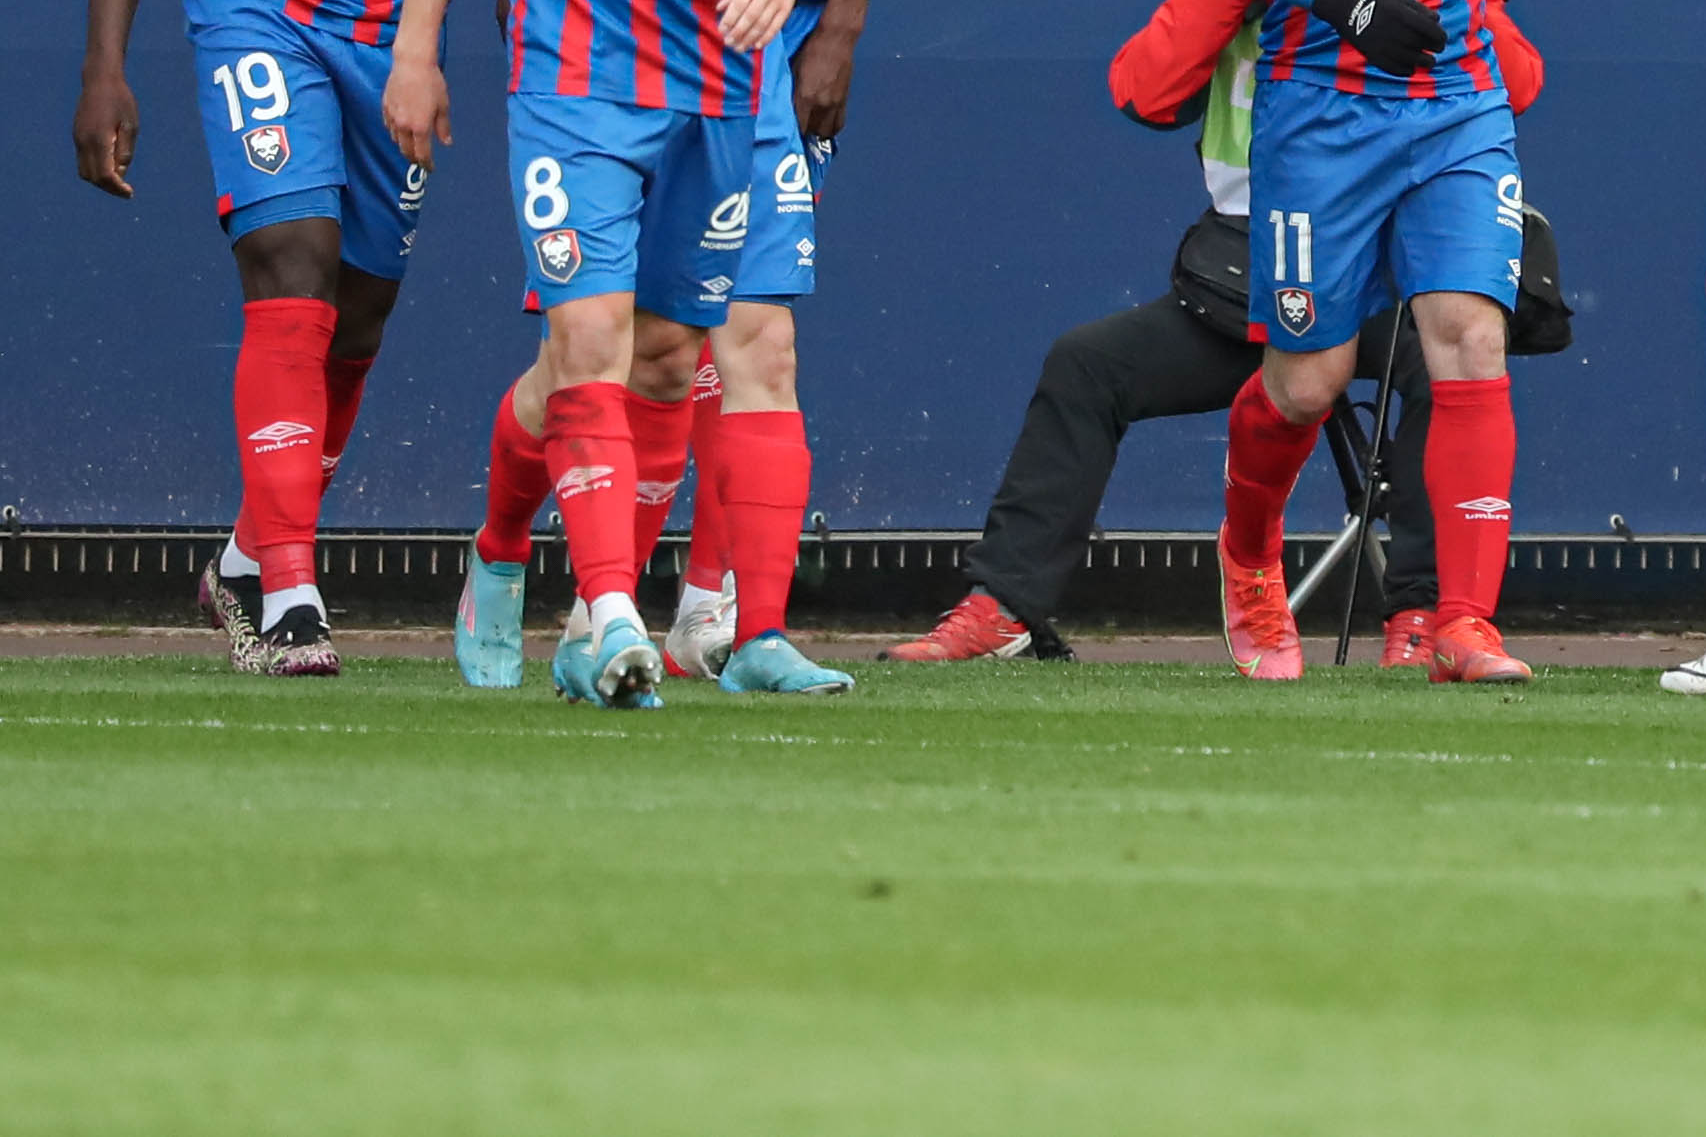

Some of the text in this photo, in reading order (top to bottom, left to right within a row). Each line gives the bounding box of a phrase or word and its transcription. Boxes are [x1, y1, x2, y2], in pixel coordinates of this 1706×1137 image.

[213, 51, 291, 133] 19
[523, 155, 570, 231] 8
[1268, 209, 1313, 283] 11
[1464, 511, 1509, 522] umbro
